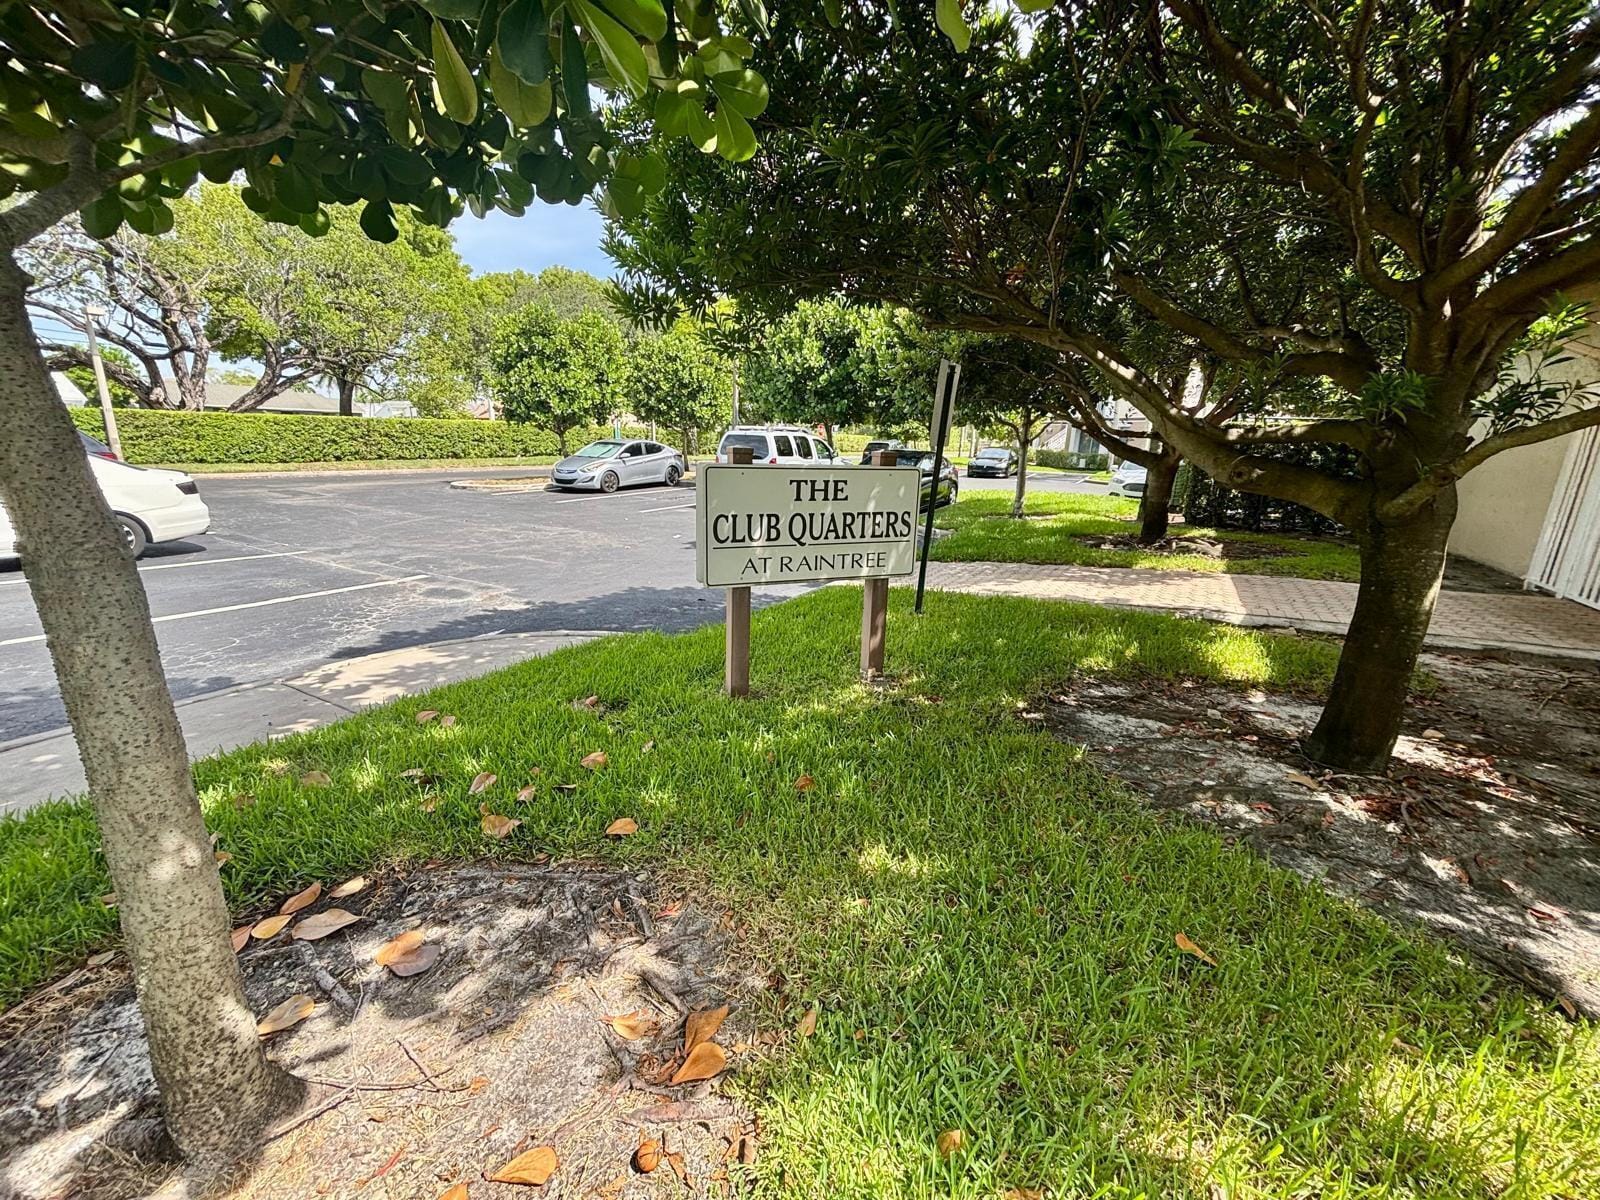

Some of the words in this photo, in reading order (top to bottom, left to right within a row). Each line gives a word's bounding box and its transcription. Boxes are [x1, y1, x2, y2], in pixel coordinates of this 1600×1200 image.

[790, 480, 849, 502] THE
[713, 513, 781, 544] CLUB
[788, 510, 911, 546] QUARTERS
[741, 557, 773, 575] AT
[780, 552, 887, 573] RAINTREE
